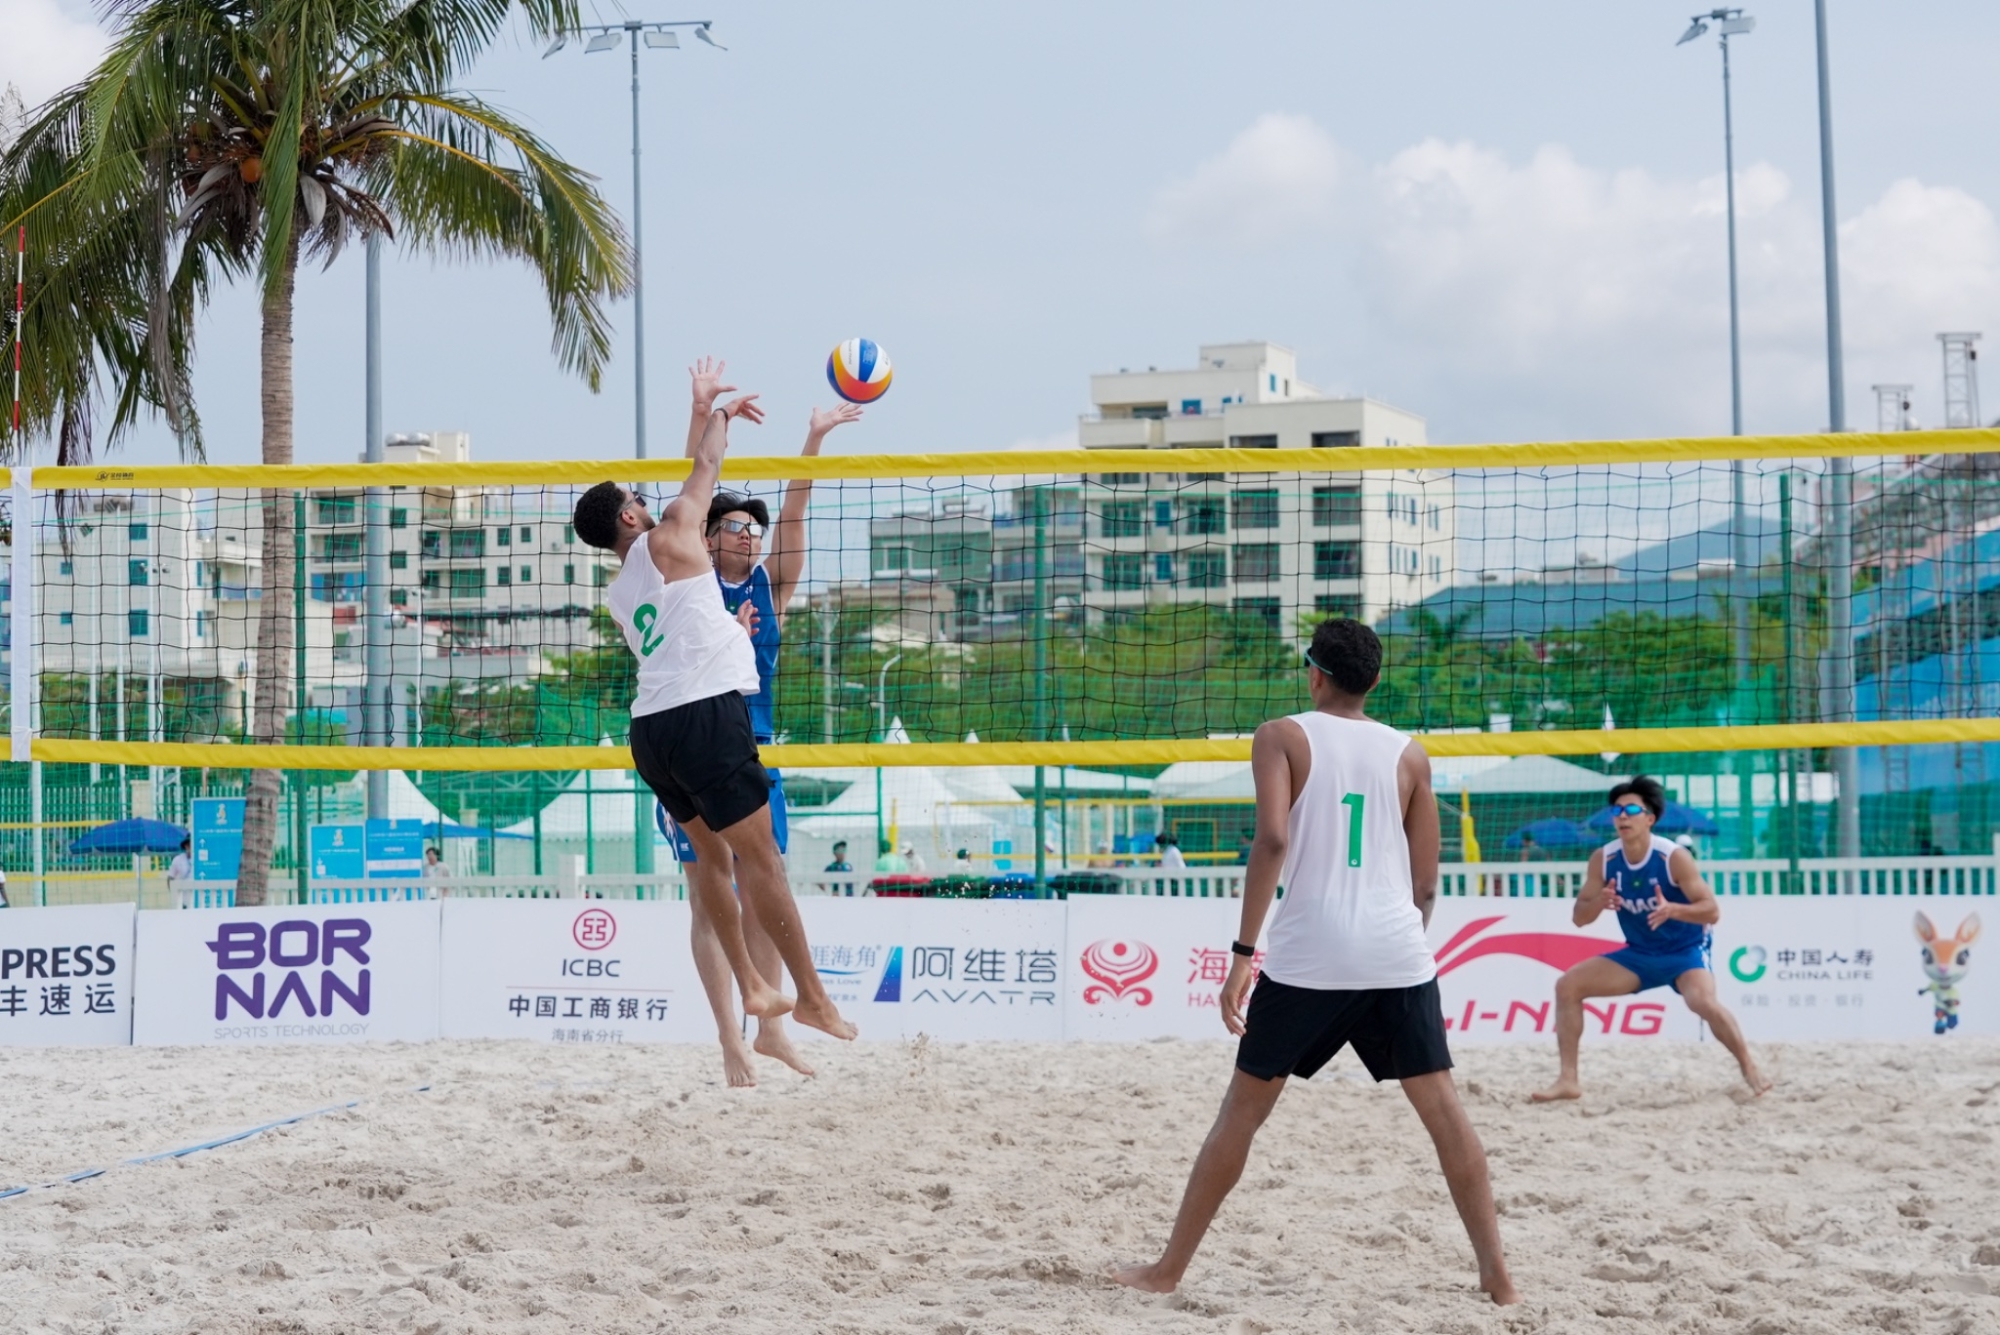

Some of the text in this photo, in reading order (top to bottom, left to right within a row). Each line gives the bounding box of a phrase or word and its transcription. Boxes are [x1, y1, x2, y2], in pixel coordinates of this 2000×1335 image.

[633, 603, 664, 657] 2
[1341, 792, 1365, 868] 1
[205, 918, 372, 970] BOR
[1777, 948, 1873, 966] 中国人寿
[1, 944, 116, 979] PRESS
[562, 959, 621, 977] ICBC
[912, 946, 1057, 983] 阿维塔
[1777, 970, 1873, 980] CHINA LIFE
[0, 983, 116, 1017] 丰速运
[214, 969, 371, 1021] NAN
[508, 995, 668, 1021] 中国工商银行
[912, 989, 1056, 1005] AVATR
[214, 1023, 370, 1039] SPORTS TECHNOLOGY
[1445, 1000, 1666, 1036] I-NNG
[551, 1028, 624, 1043] 海南省分行
